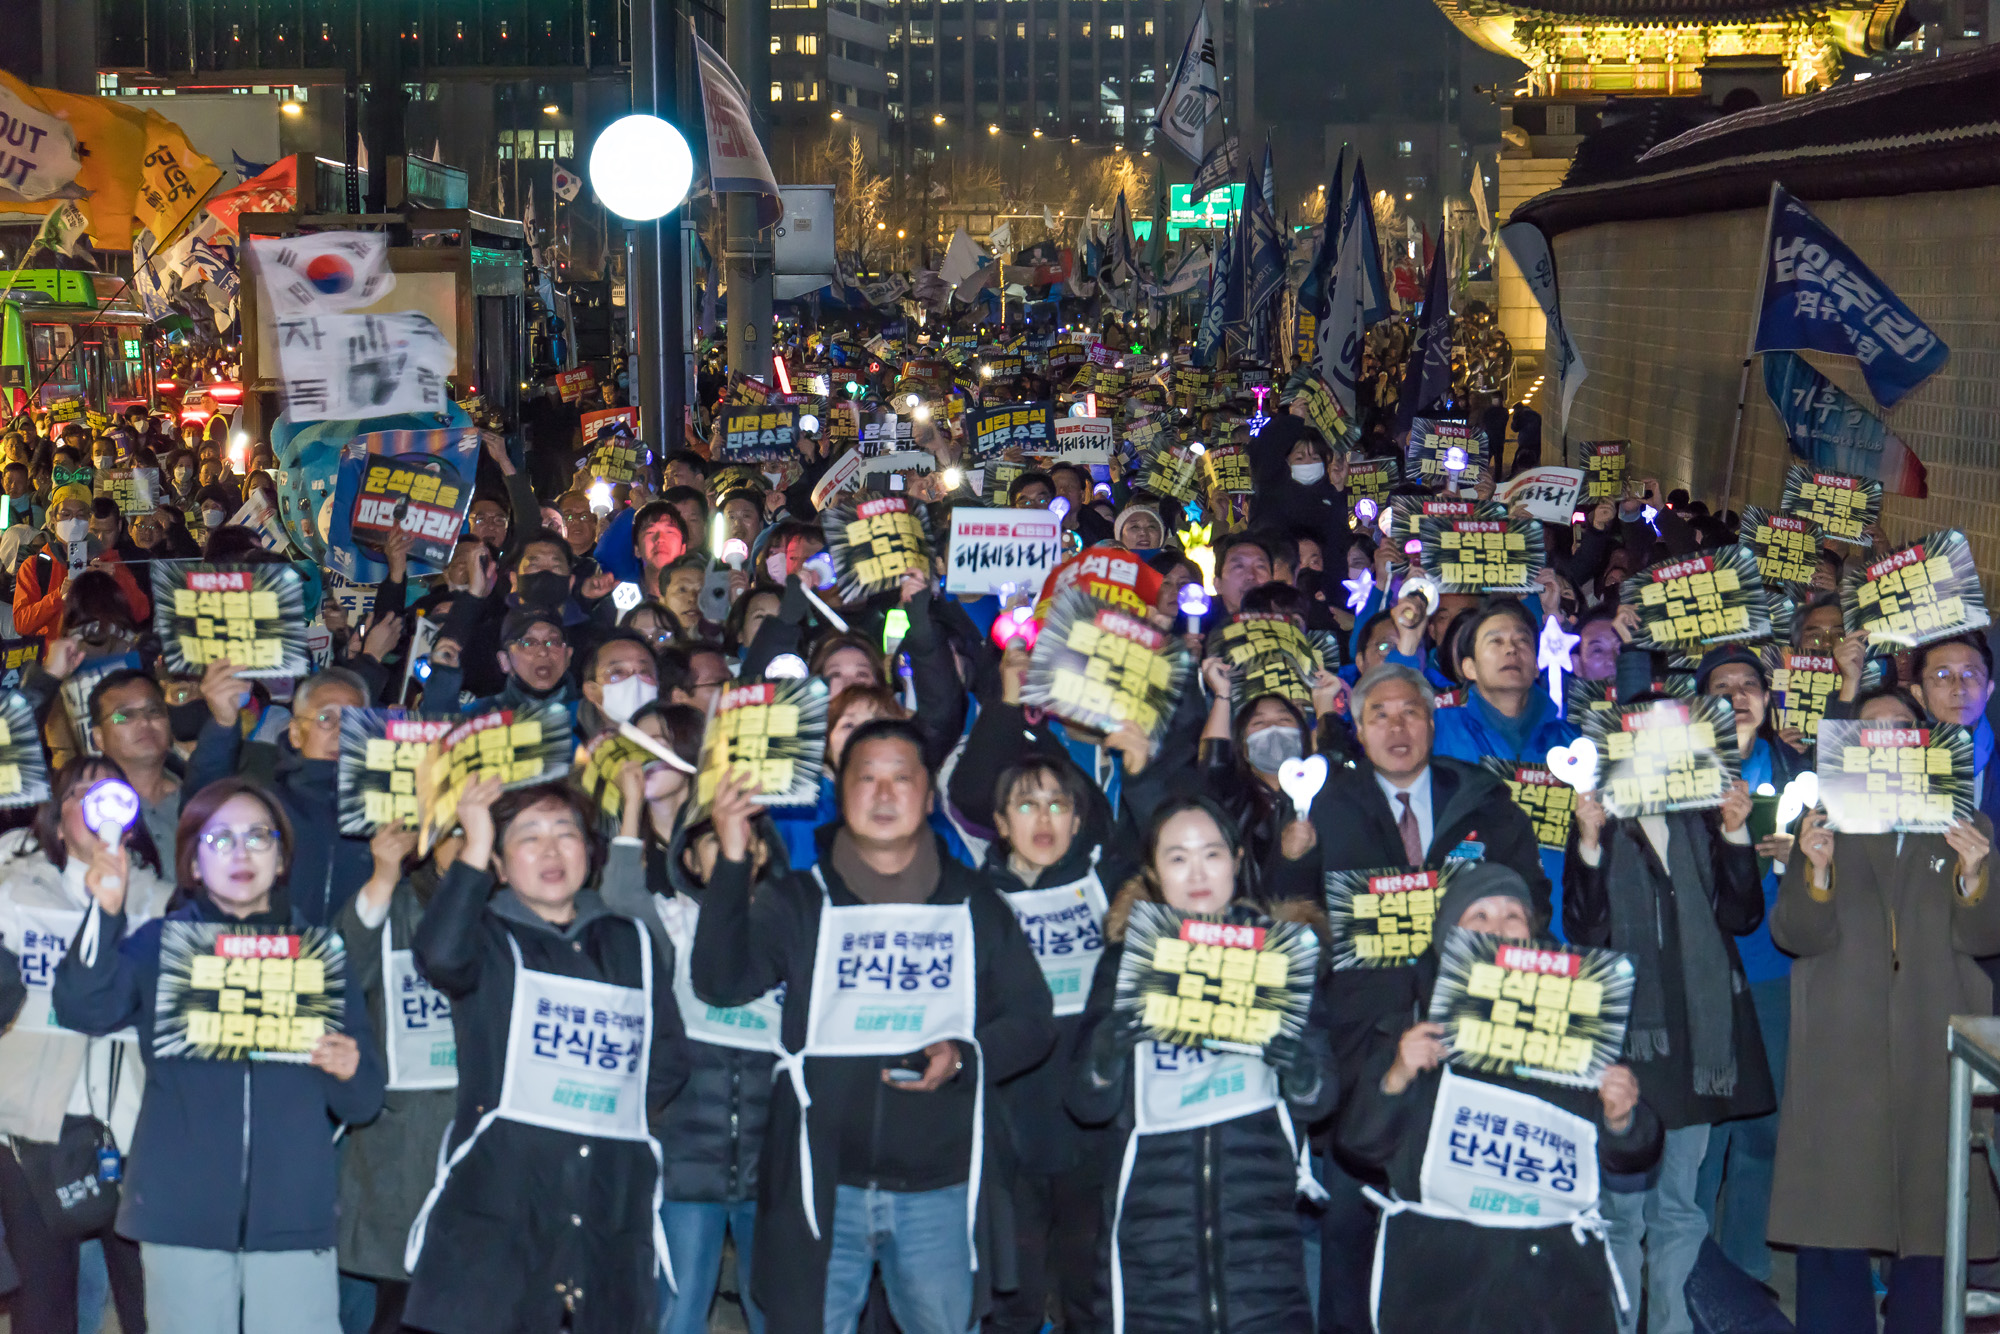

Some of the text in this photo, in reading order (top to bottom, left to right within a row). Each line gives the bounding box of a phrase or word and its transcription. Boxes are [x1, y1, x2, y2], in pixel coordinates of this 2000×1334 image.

[364, 466, 460, 509] 윤석열을
[1800, 482, 1868, 510] 윤석열을
[958, 523, 1010, 536] 내란동조
[1440, 531, 1527, 551] 윤석열을
[1441, 563, 1528, 585] 파면하라
[1640, 568, 1741, 607] 윤석열을
[1857, 555, 1954, 608] 윤석열을
[1649, 605, 1751, 643] 파면하라
[1843, 746, 1953, 775] 윤석열을
[842, 929, 954, 953] 윤석열 즉각파면
[190, 954, 326, 994] 윤석열을
[837, 953, 954, 991] 단식농성
[1152, 936, 1290, 989] 윤석열을
[1467, 962, 1603, 1018] 윤석열을
[536, 996, 587, 1024] 윤석열
[1142, 991, 1282, 1044] 파면하라
[1453, 1017, 1595, 1074] 파면하라
[1454, 1105, 1578, 1157] 윤석열 즉각파면
[1449, 1130, 1579, 1193] 단식농성
